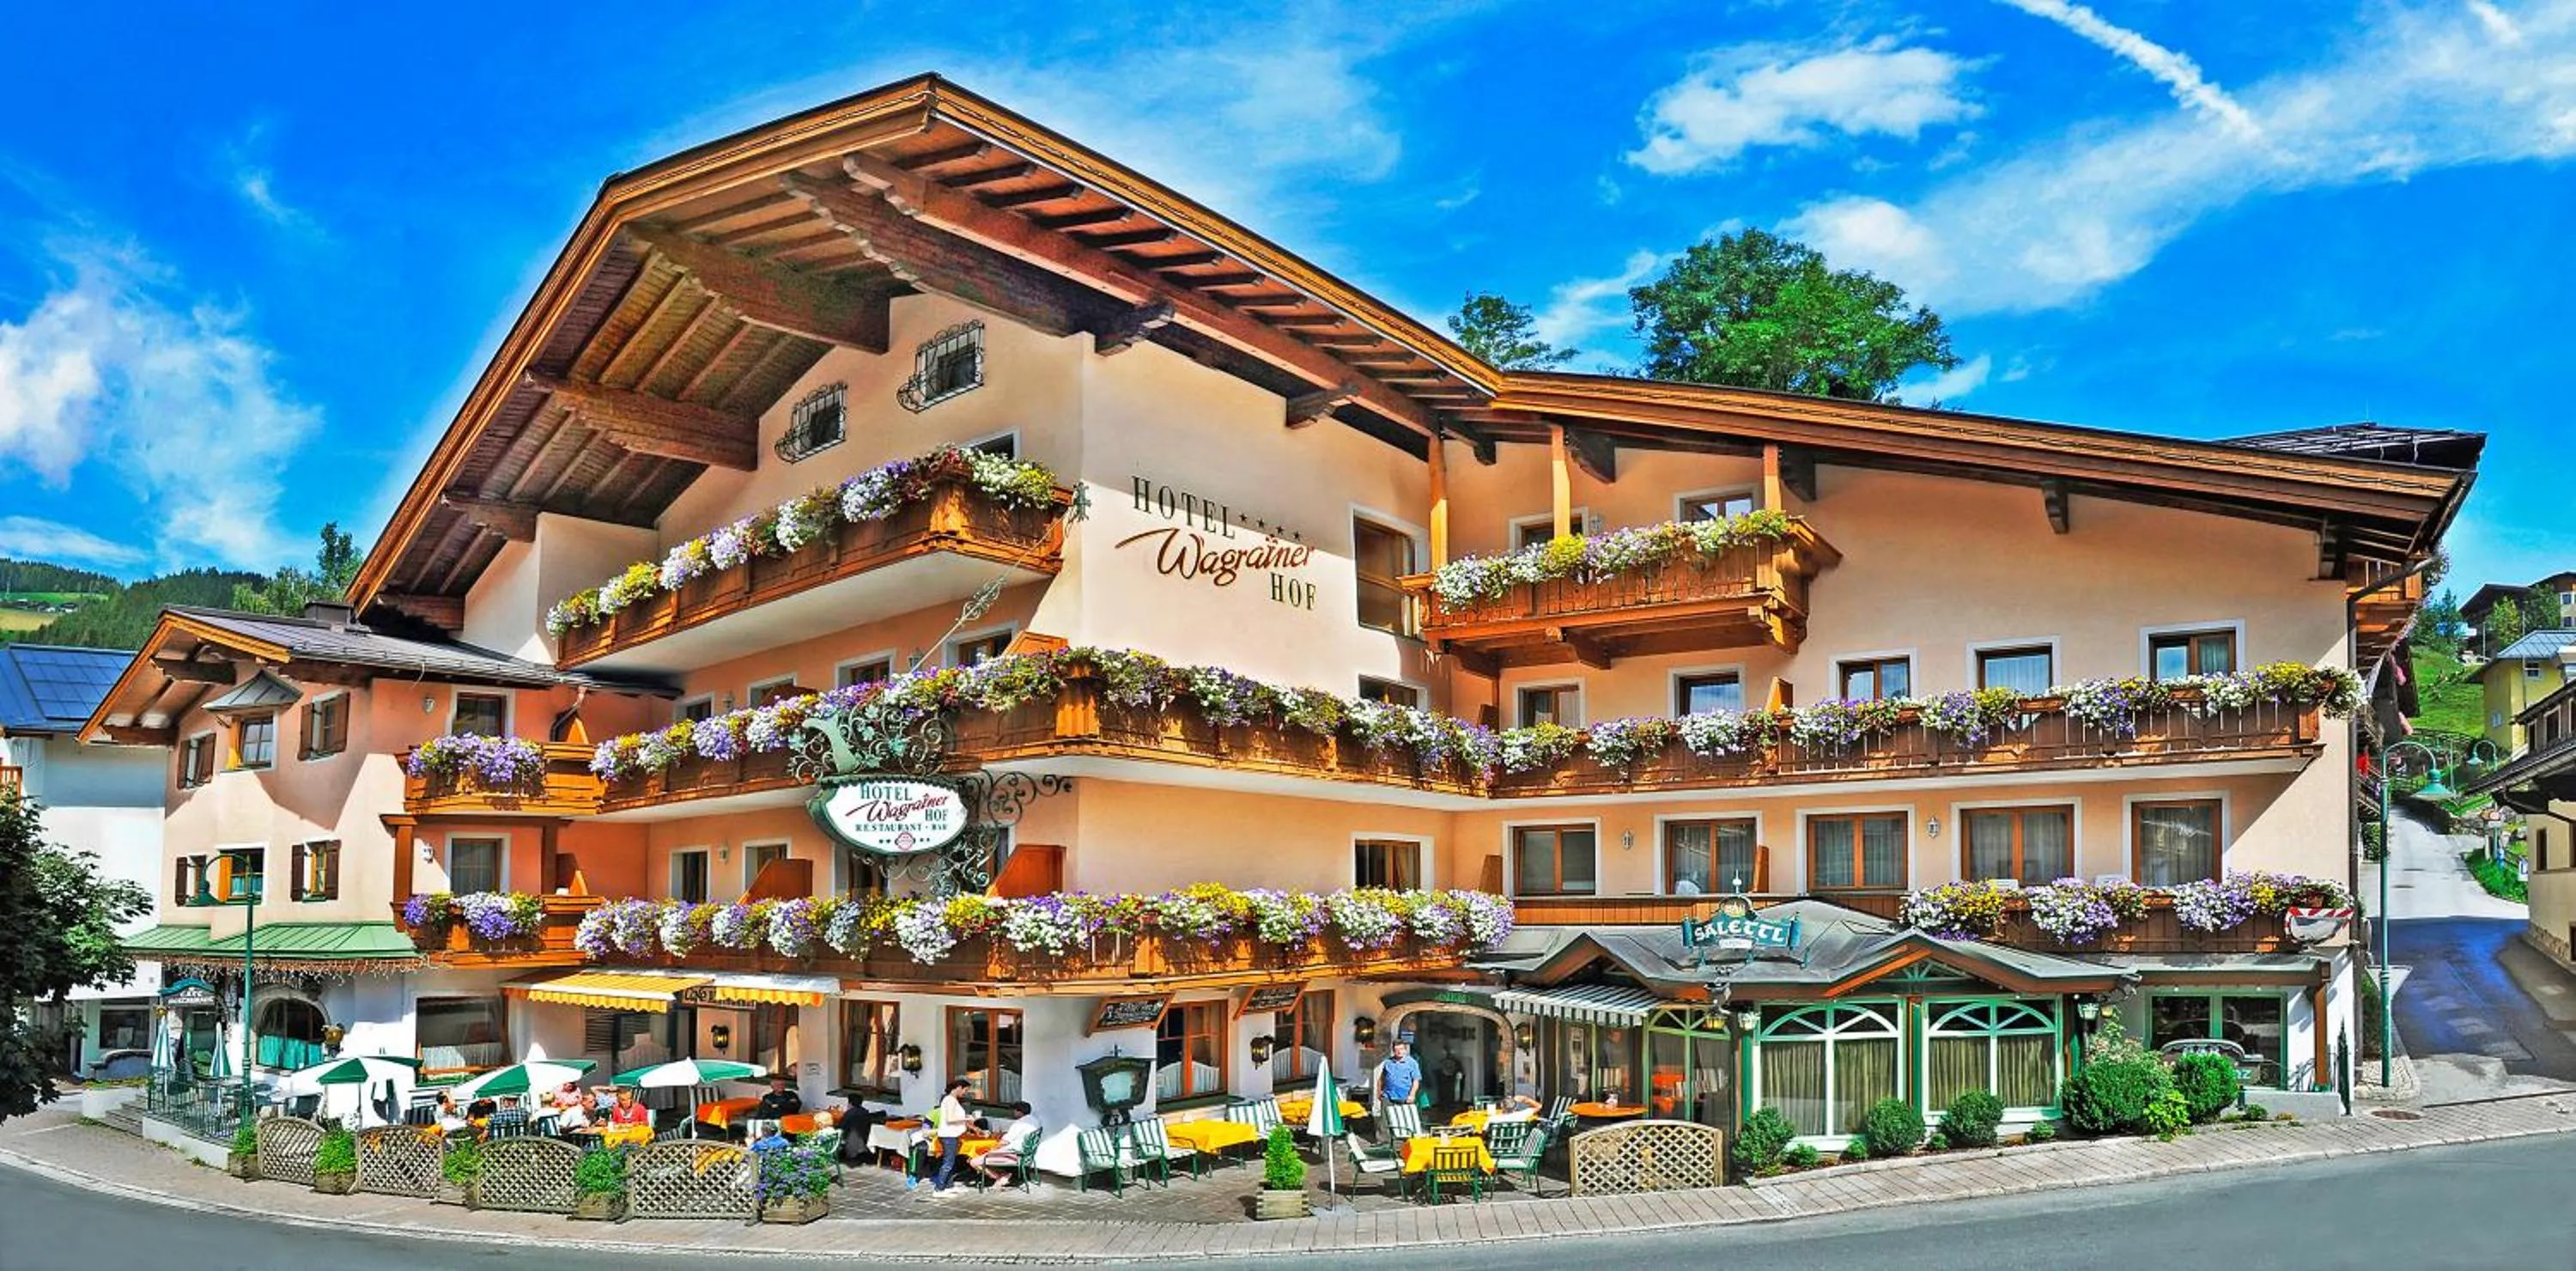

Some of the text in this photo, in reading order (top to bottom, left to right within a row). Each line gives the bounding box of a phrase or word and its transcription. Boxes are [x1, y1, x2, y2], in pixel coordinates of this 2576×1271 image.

[1131, 475, 1236, 539] HOTEL
[1270, 572, 1317, 611] HOF
[860, 782, 913, 801] HOTEL
[925, 808, 948, 822] HOF
[855, 823, 922, 832] RESTAURANT
